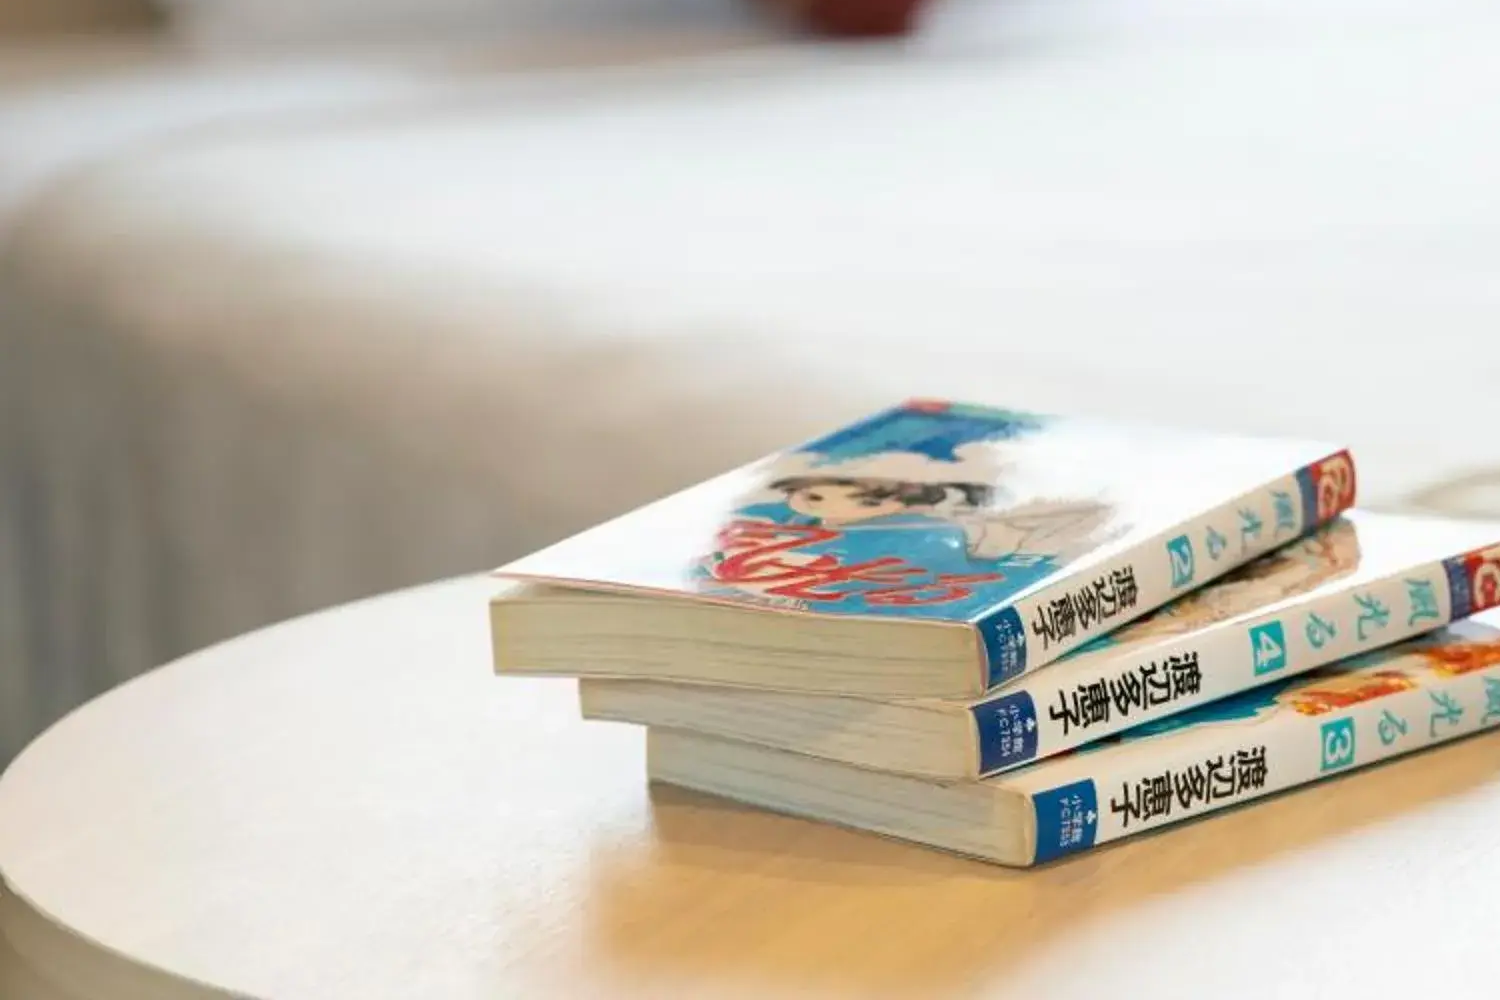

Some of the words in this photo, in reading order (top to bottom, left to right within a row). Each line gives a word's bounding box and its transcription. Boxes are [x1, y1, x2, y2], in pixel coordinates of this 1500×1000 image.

[1170, 543, 1194, 582] 2
[1032, 566, 1138, 650] 渡辺多恵子
[1305, 577, 1441, 649] 風光る
[1257, 630, 1283, 668] 4
[1049, 651, 1202, 735] 渡辺多恵子
[1324, 727, 1351, 764] 3
[1111, 746, 1268, 827] 渡辺多恵子
